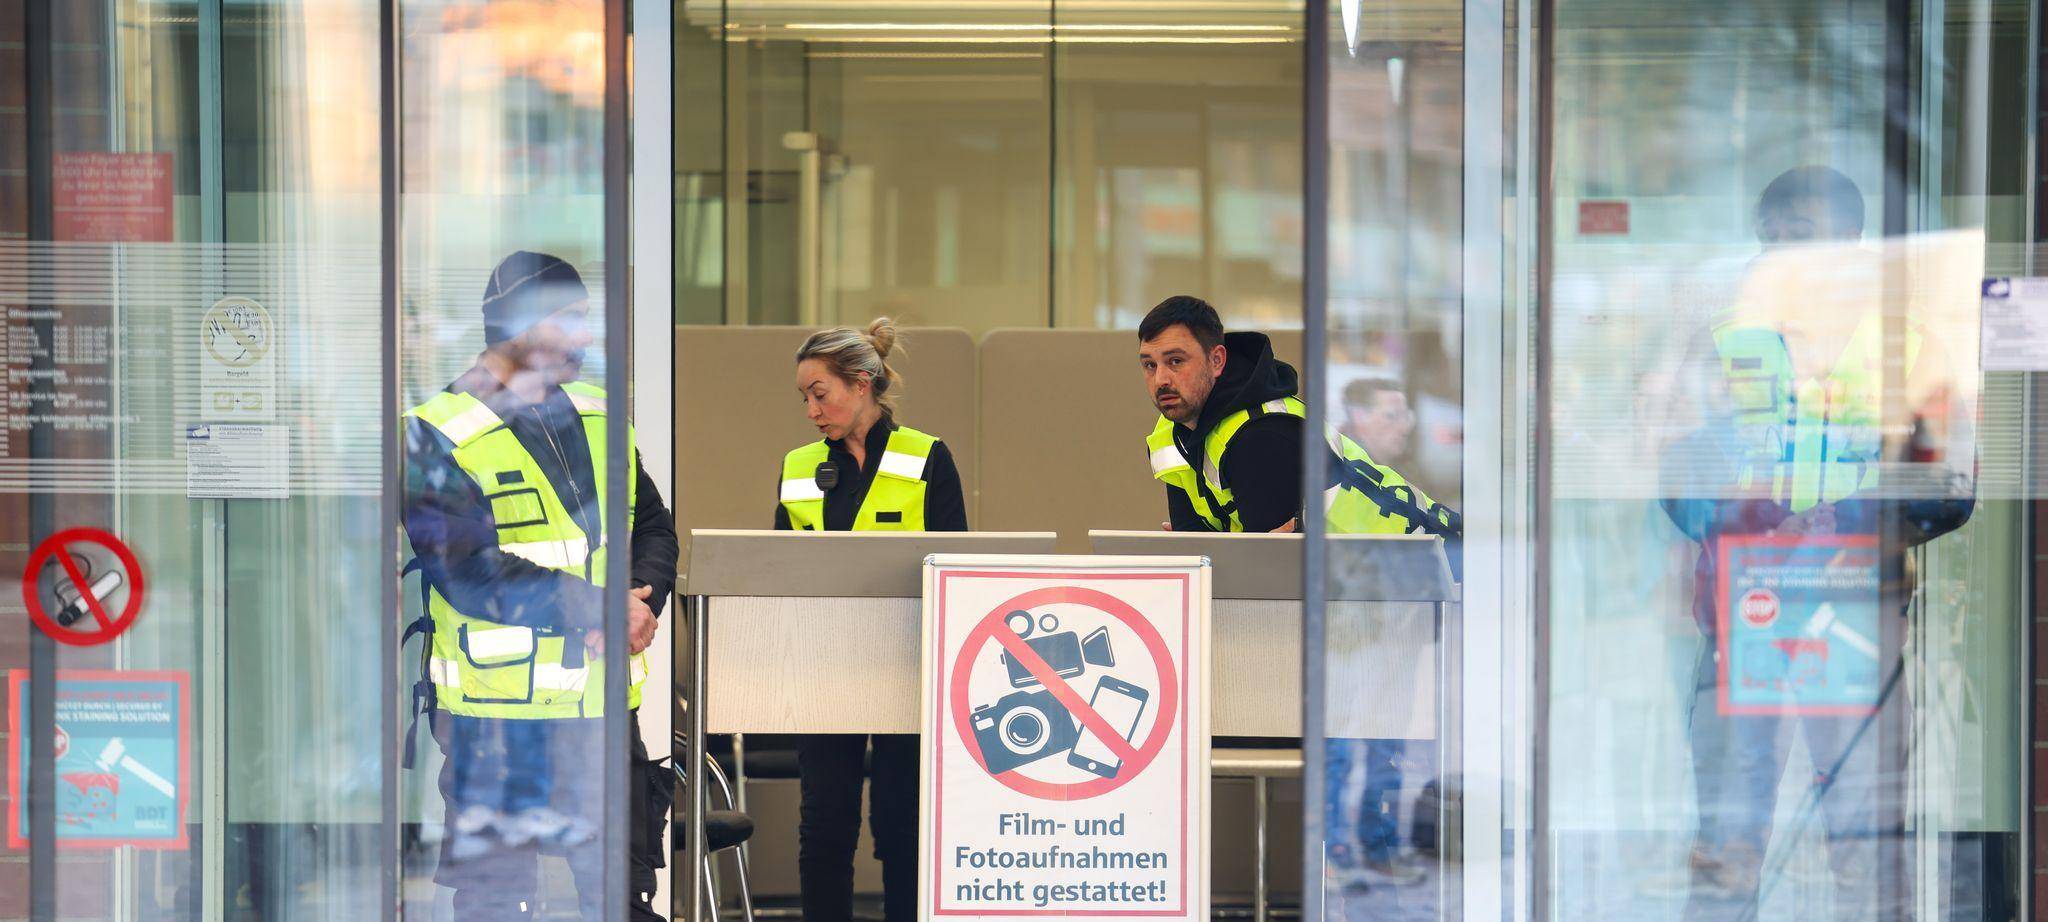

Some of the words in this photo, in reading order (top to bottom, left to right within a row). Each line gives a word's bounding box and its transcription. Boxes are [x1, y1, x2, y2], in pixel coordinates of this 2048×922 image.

[73, 711, 119, 722] STAINING
[120, 711, 171, 723] SOLUTION
[999, 812, 1067, 836] Film-
[1074, 812, 1125, 836] und
[955, 845, 1168, 870] Fotoaufnahmen
[956, 878, 1025, 902] nicht
[1032, 880, 1167, 907] gestattet!
